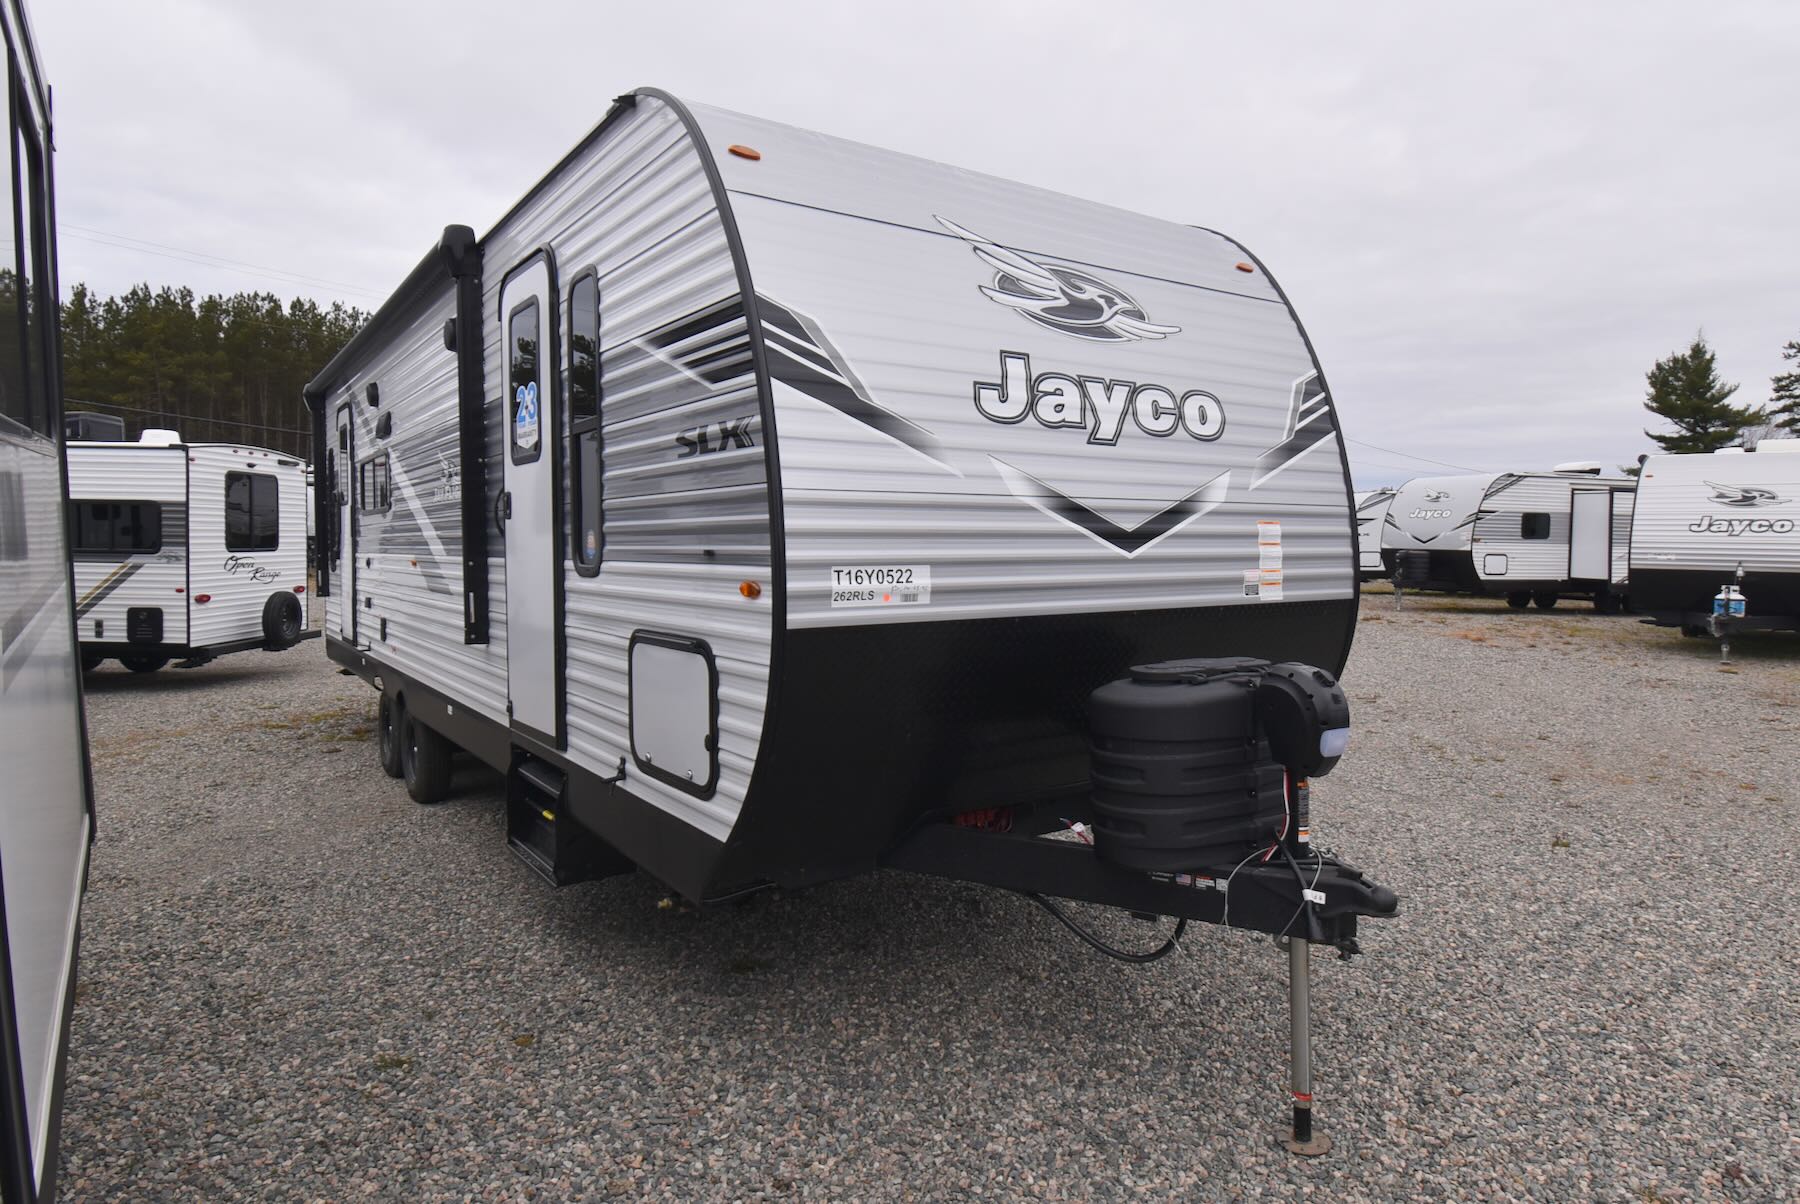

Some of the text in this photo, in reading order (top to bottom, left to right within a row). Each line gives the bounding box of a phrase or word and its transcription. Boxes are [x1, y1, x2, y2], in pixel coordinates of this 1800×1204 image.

[973, 350, 1226, 447] Jayco
[675, 414, 756, 459] SLX
[1410, 507, 1453, 521] Jayco
[1688, 515, 1795, 538] Jayco
[223, 555, 255, 576] Open
[247, 566, 282, 585] Range
[833, 568, 914, 586] T16Y0522
[833, 590, 875, 602] 262RLS
